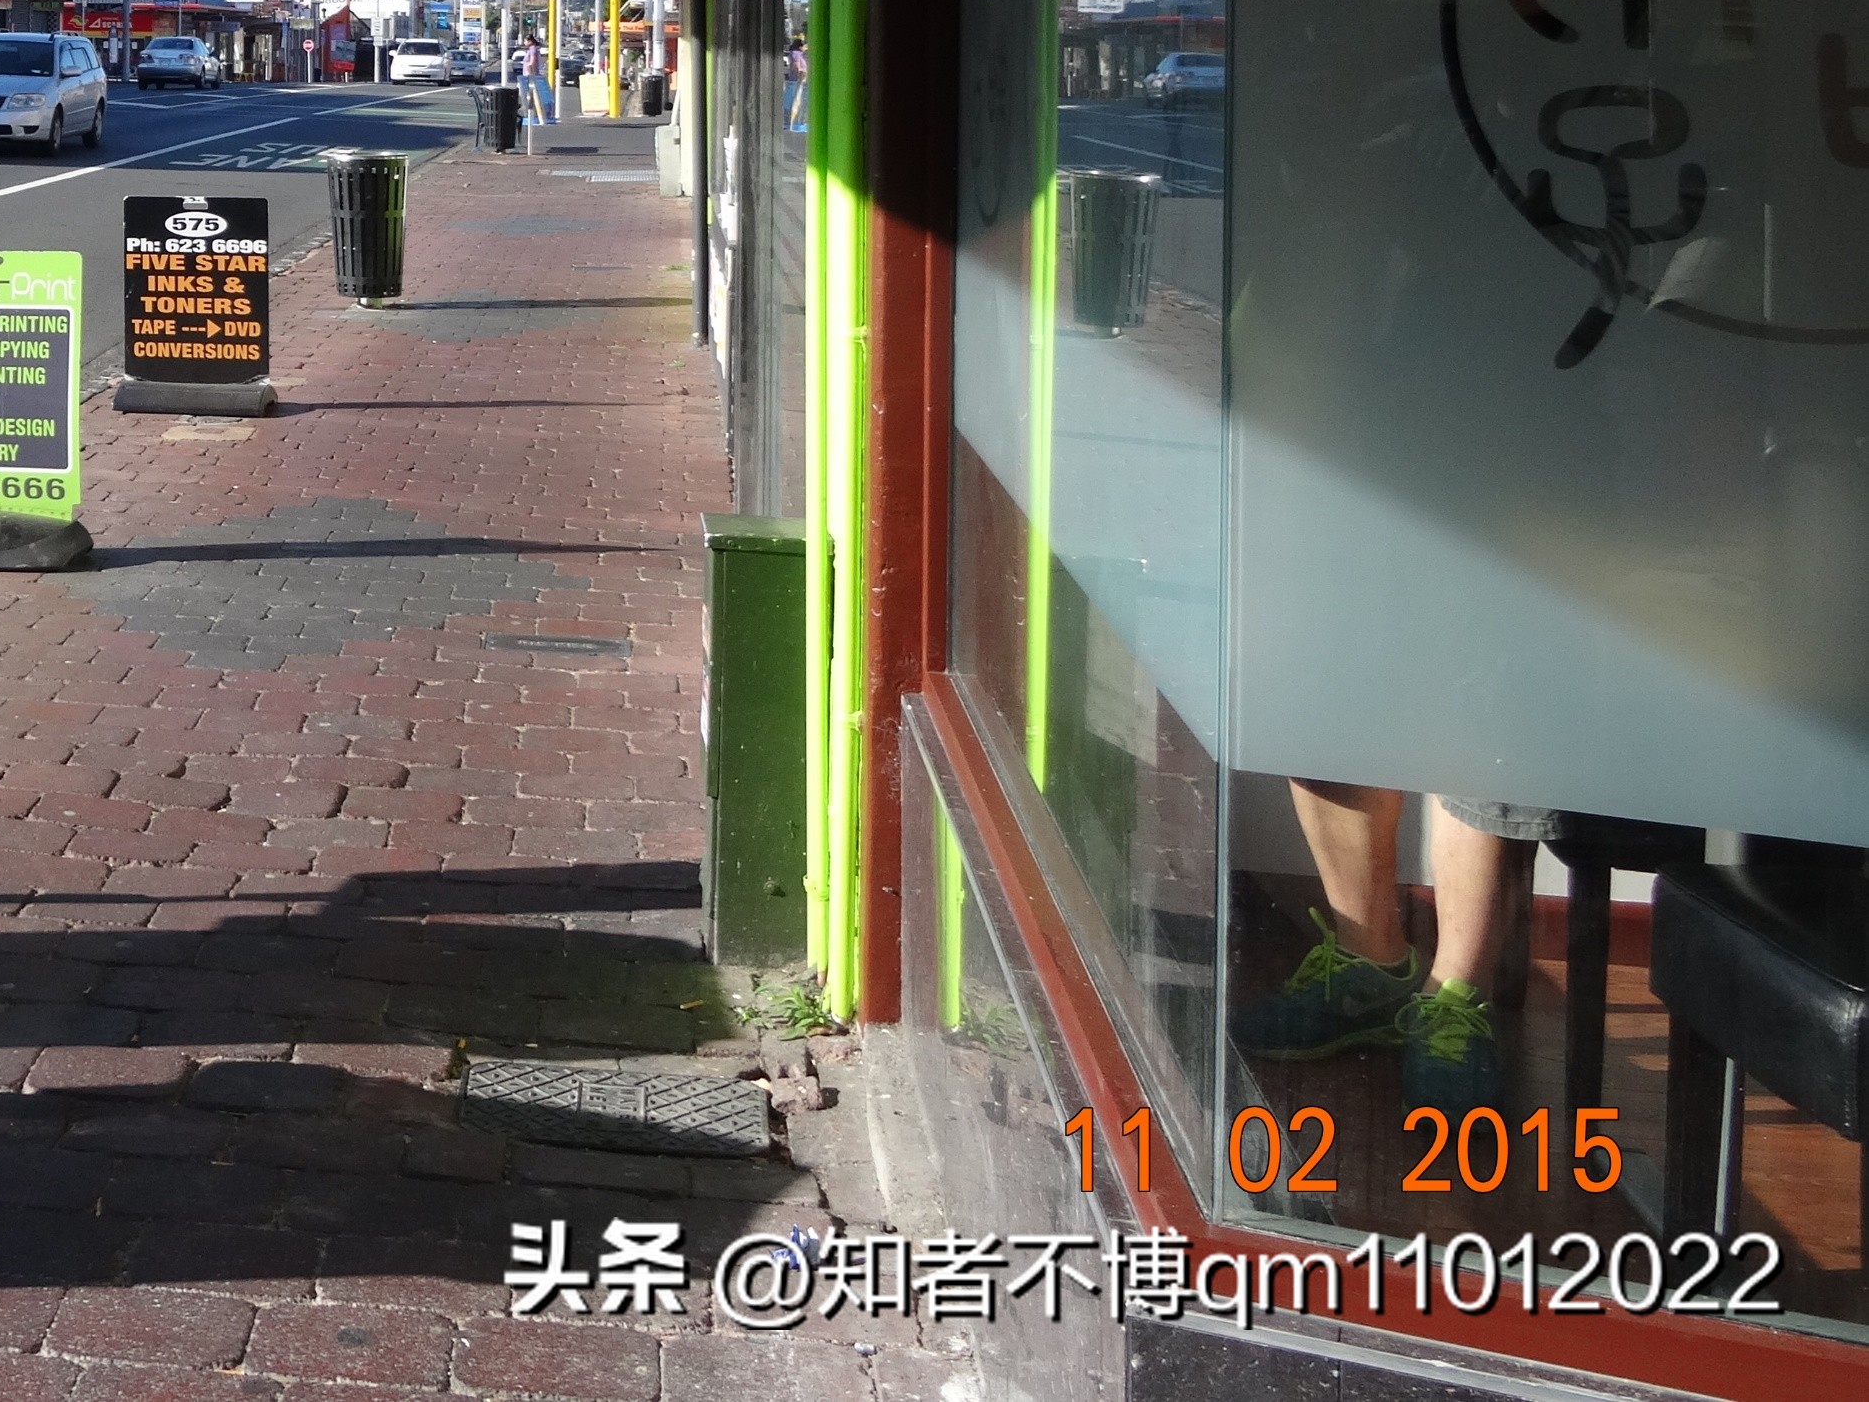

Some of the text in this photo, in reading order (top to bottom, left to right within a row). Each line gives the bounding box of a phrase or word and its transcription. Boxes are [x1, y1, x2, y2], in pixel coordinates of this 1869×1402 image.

[172, 218, 219, 231] 575
[126, 238, 267, 254] Ph: 623 6696
[126, 254, 266, 271] FIVE STAR
[148, 275, 245, 293] INKS &
[140, 297, 251, 315] TONERS
[131, 319, 261, 337] TAPE DVD
[133, 342, 260, 360] CONVERSIONS
